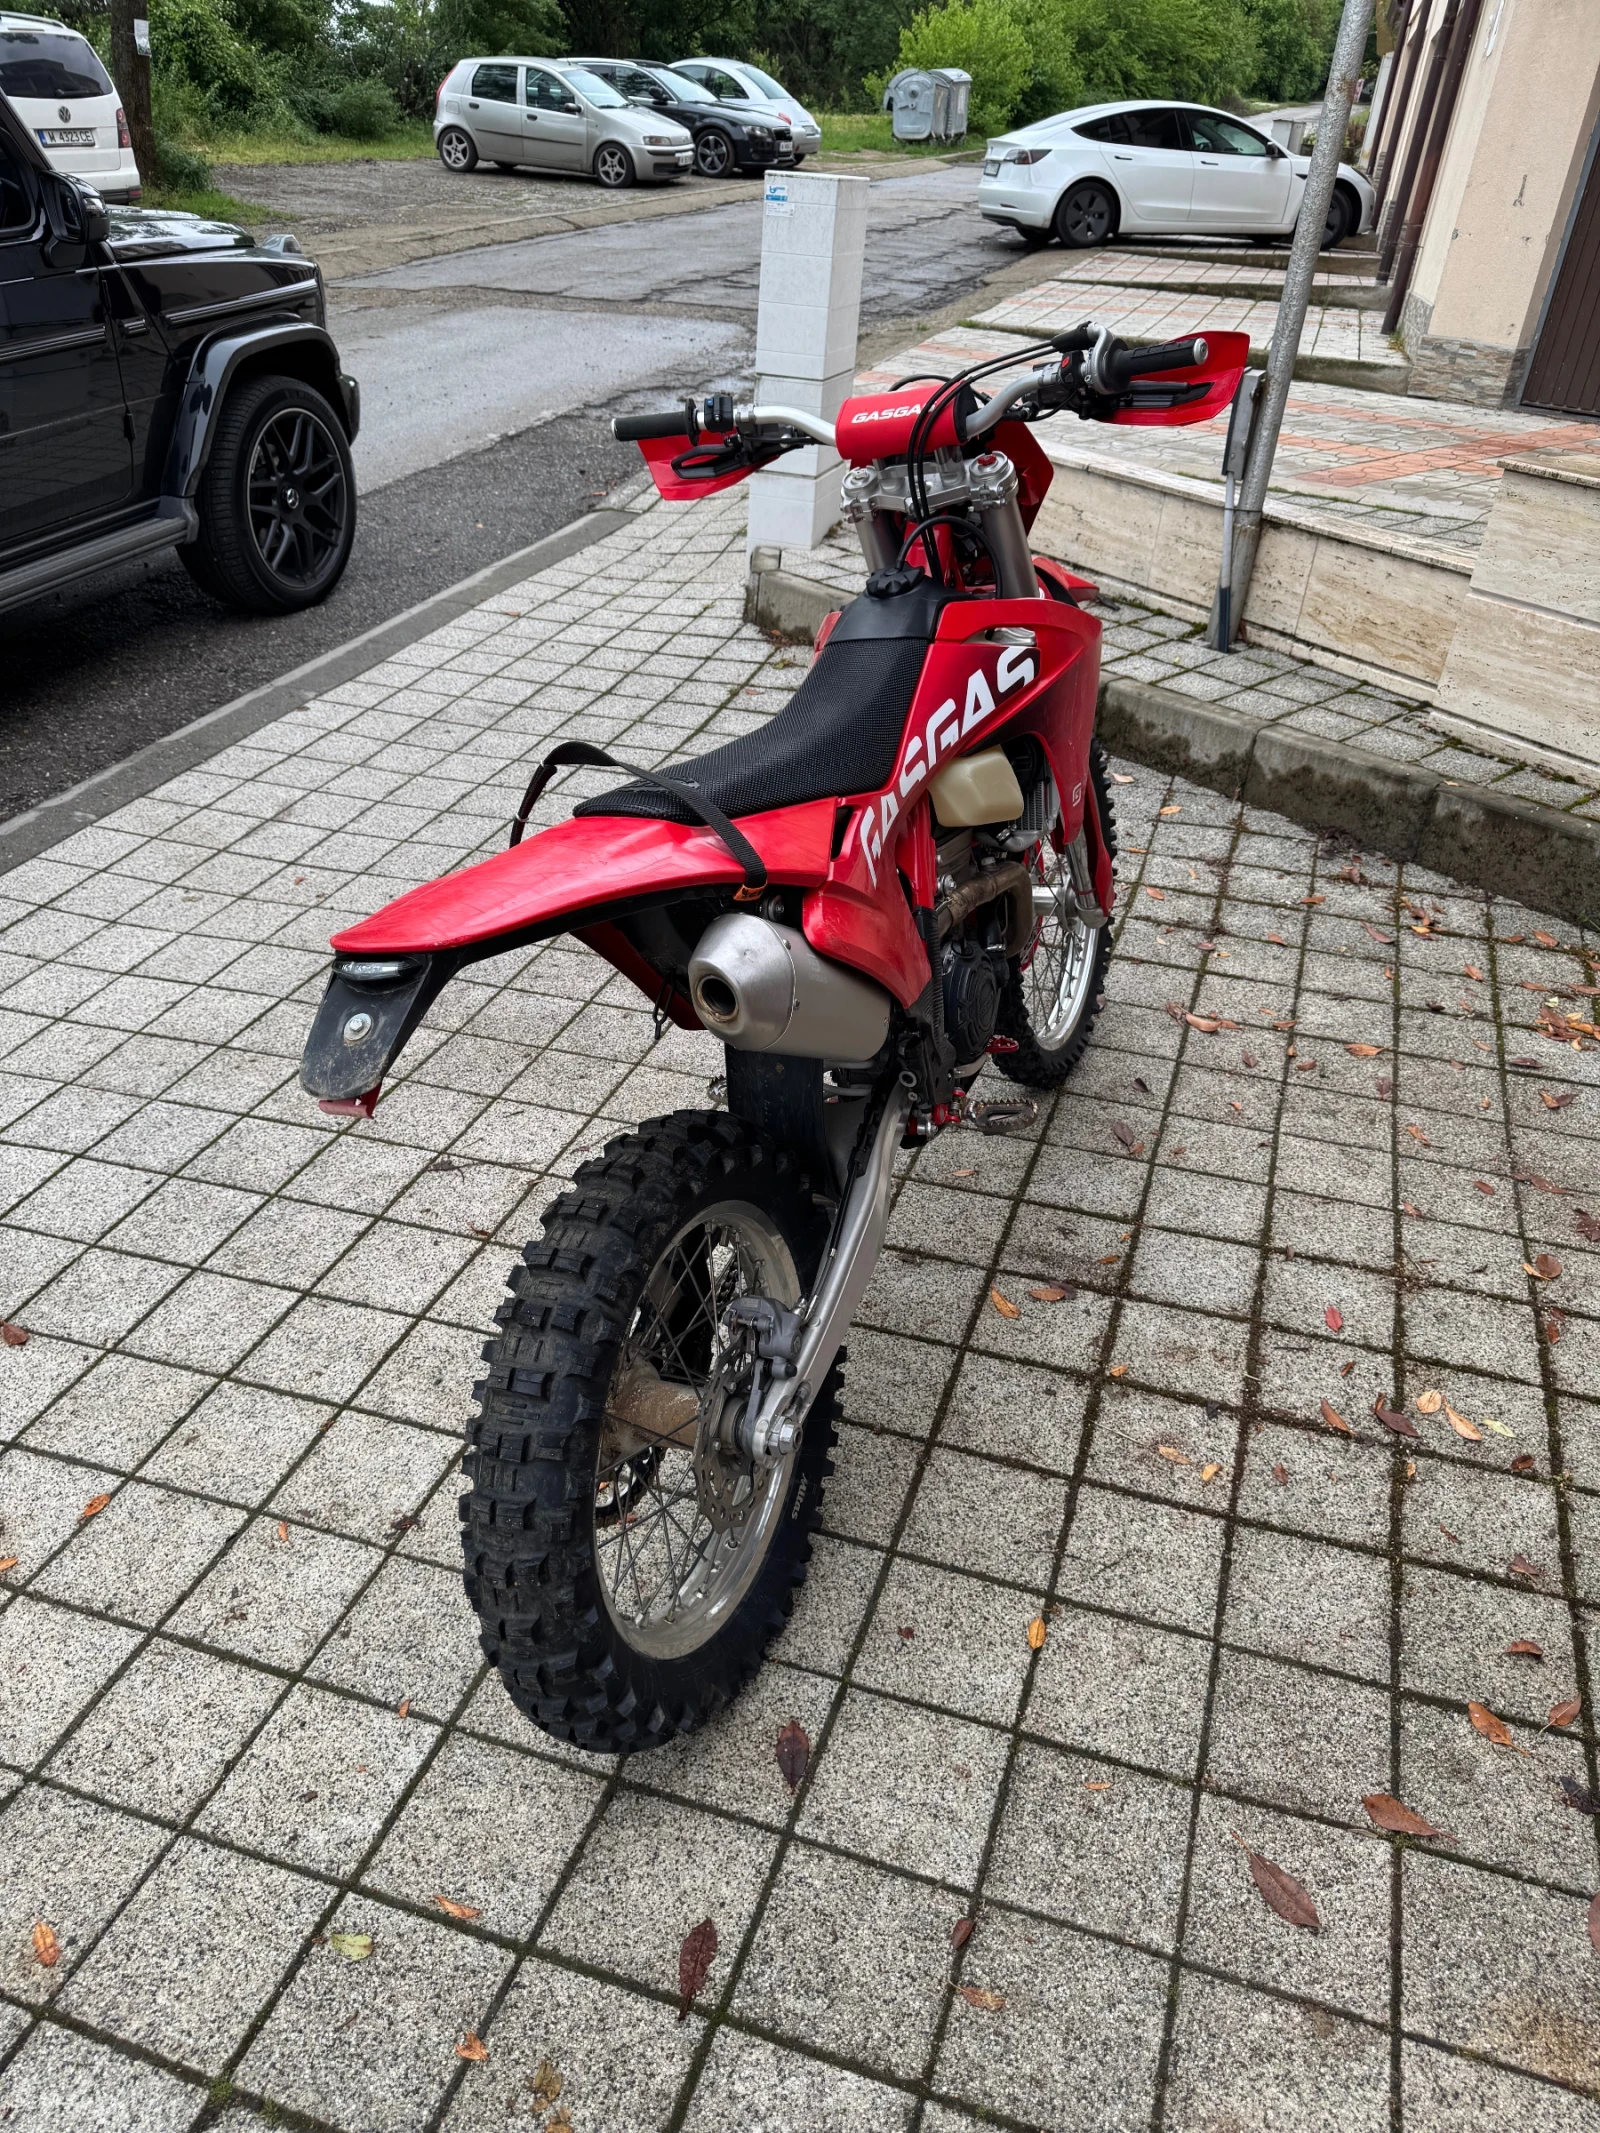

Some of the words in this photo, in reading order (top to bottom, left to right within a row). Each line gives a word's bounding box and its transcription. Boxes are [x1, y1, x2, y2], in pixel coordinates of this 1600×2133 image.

[59, 131, 80, 142] 4323
[79, 131, 93, 142] CE
[860, 646, 1036, 888] GASGAS
